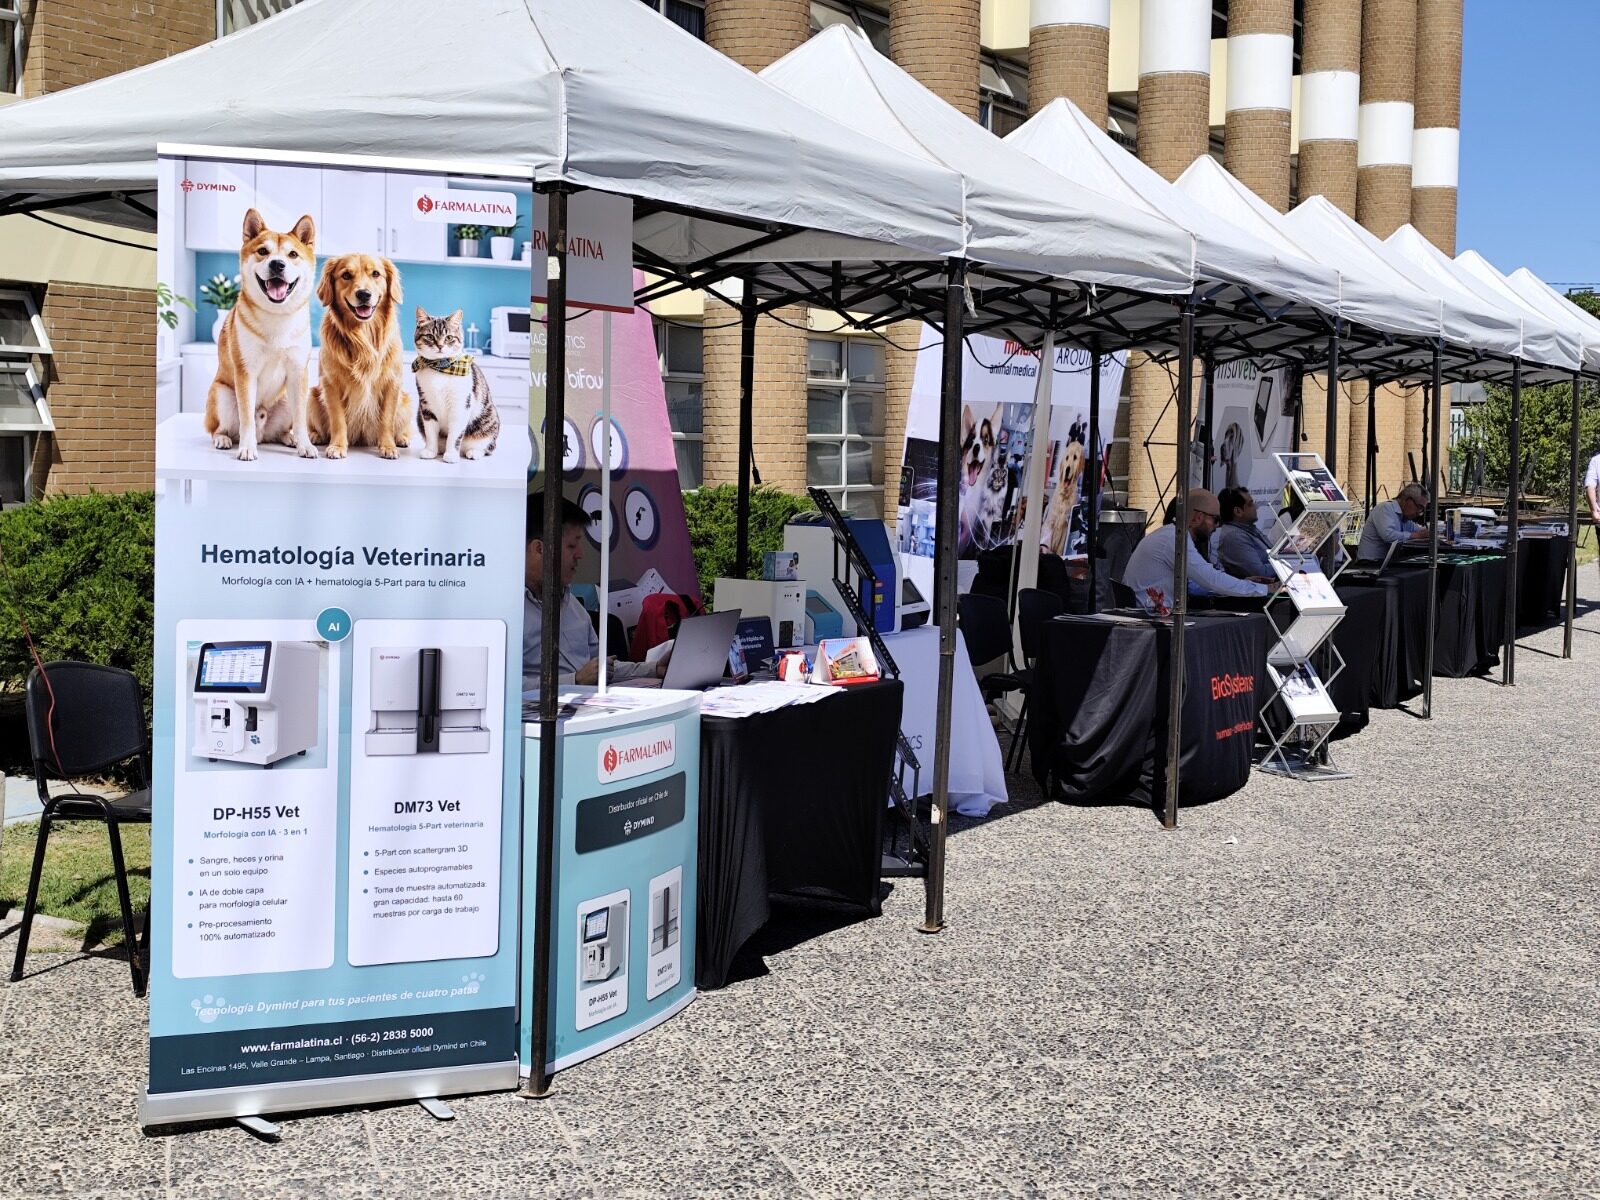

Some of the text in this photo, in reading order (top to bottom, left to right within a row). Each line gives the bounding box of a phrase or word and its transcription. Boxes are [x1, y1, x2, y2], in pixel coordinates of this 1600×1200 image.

[196, 183, 237, 192] DYMIND
[434, 200, 513, 215] FARMALATINA
[1012, 365, 1037, 378] medical
[201, 544, 486, 570] Hematología Veterinaria
[221, 576, 273, 588] Morfología
[274, 578, 292, 587] con
[294, 577, 305, 586] IA
[315, 577, 372, 588] hematología
[374, 578, 403, 588] 5-Part
[405, 579, 426, 588] para
[428, 579, 437, 587] tu
[438, 579, 467, 588] clínica
[327, 622, 340, 632] AI
[618, 739, 672, 766] FARMALATINA
[213, 805, 300, 821] DP-H55 Vet
[394, 799, 461, 814] DM73 Vet
[418, 822, 442, 830] 5-Part
[443, 820, 484, 829] veterinaria
[633, 816, 655, 830] DYMIND
[374, 849, 397, 857] 5-Part
[398, 848, 411, 856] con
[413, 846, 456, 854] scattergram
[200, 854, 284, 865] Sangre, heces y orina
[223, 868, 240, 876] solo
[242, 867, 268, 876] equipo
[374, 863, 473, 876] Especies autoprogramables
[209, 888, 219, 896] de
[222, 887, 243, 895] doble
[245, 887, 264, 895] capa
[374, 886, 393, 894] Toma
[406, 884, 435, 892] muestra
[199, 901, 217, 910] para
[262, 897, 288, 905] celular
[373, 900, 389, 908] gran
[453, 893, 463, 901] 60
[373, 910, 406, 918] muestras
[408, 909, 419, 917] por
[421, 907, 442, 916] carga
[455, 905, 479, 914] trabajo
[199, 918, 272, 928] Pre-procesamiento
[199, 930, 275, 941] 100% automatizado
[194, 986, 479, 1016] Tecnología Dymind para tus pacientes de cuatro patas
[241, 1035, 343, 1054] www.farmalatina.cl
[351, 1032, 380, 1046] (56-2)
[383, 1029, 407, 1041] 2838
[410, 1027, 434, 1038] 5000
[181, 1067, 195, 1075] Las
[196, 1065, 226, 1073] Encinas
[228, 1063, 249, 1071] 1495,
[270, 1058, 298, 1067] Grande
[305, 1055, 331, 1064] Lampa,
[333, 1051, 365, 1060] Santiago
[371, 1047, 410, 1057] Distribuidor
[433, 1043, 458, 1052] Dymind
